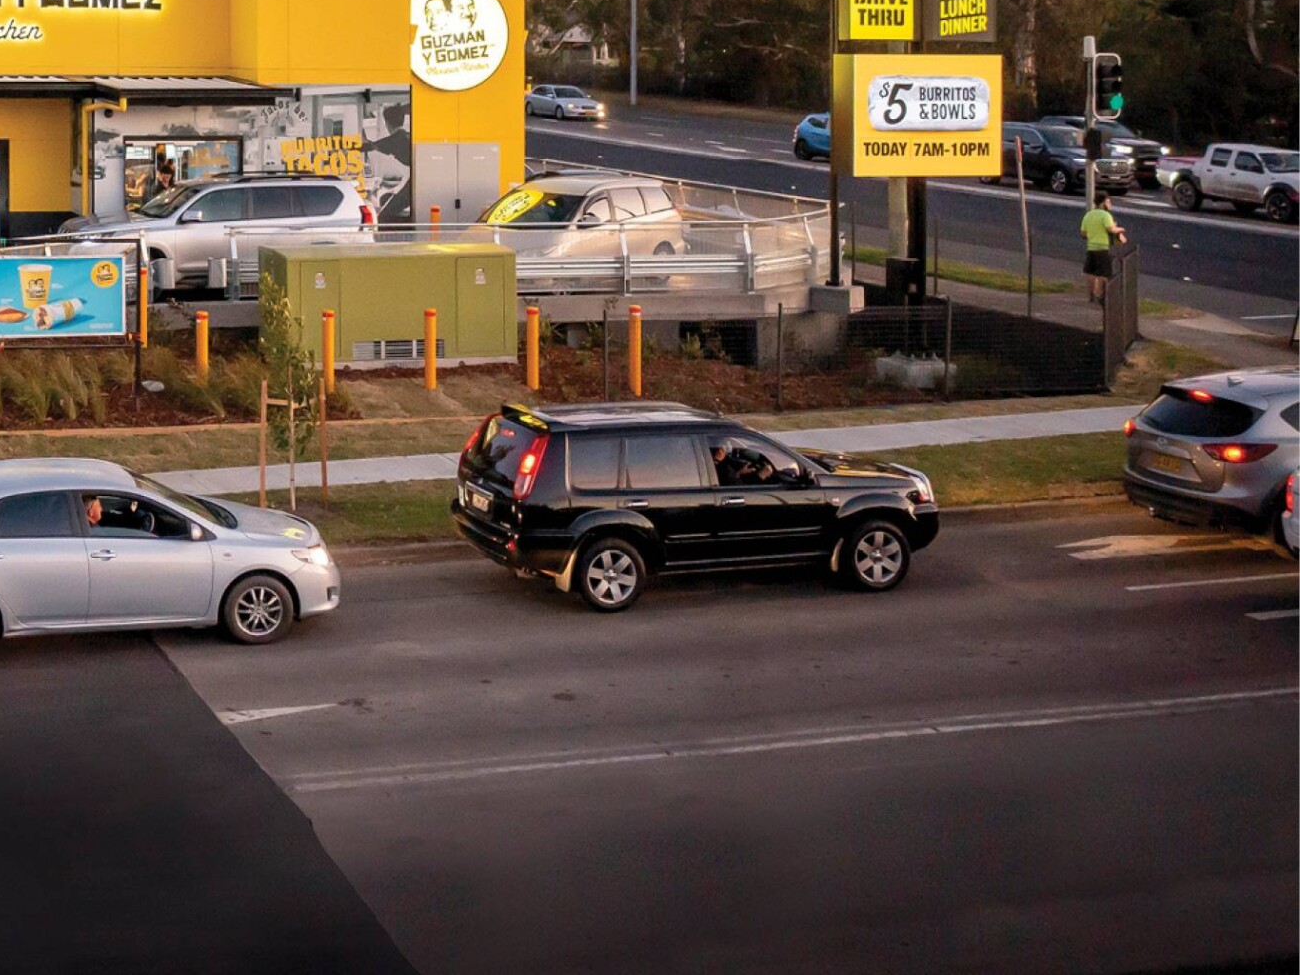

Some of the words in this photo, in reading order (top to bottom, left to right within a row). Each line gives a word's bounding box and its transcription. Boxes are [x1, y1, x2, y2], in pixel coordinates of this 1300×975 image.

[857, 8, 905, 26] THRU
[940, 15, 988, 37] DINNER
[421, 29, 486, 50] GUZMAN
[422, 51, 432, 66] Y
[878, 81, 914, 125] $5
[919, 86, 977, 102] BURRITOS
[280, 133, 363, 156] BURRITOS
[863, 142, 907, 157] TODAY
[913, 142, 990, 157] 7AM-10PM
[283, 149, 364, 176] TACOS
